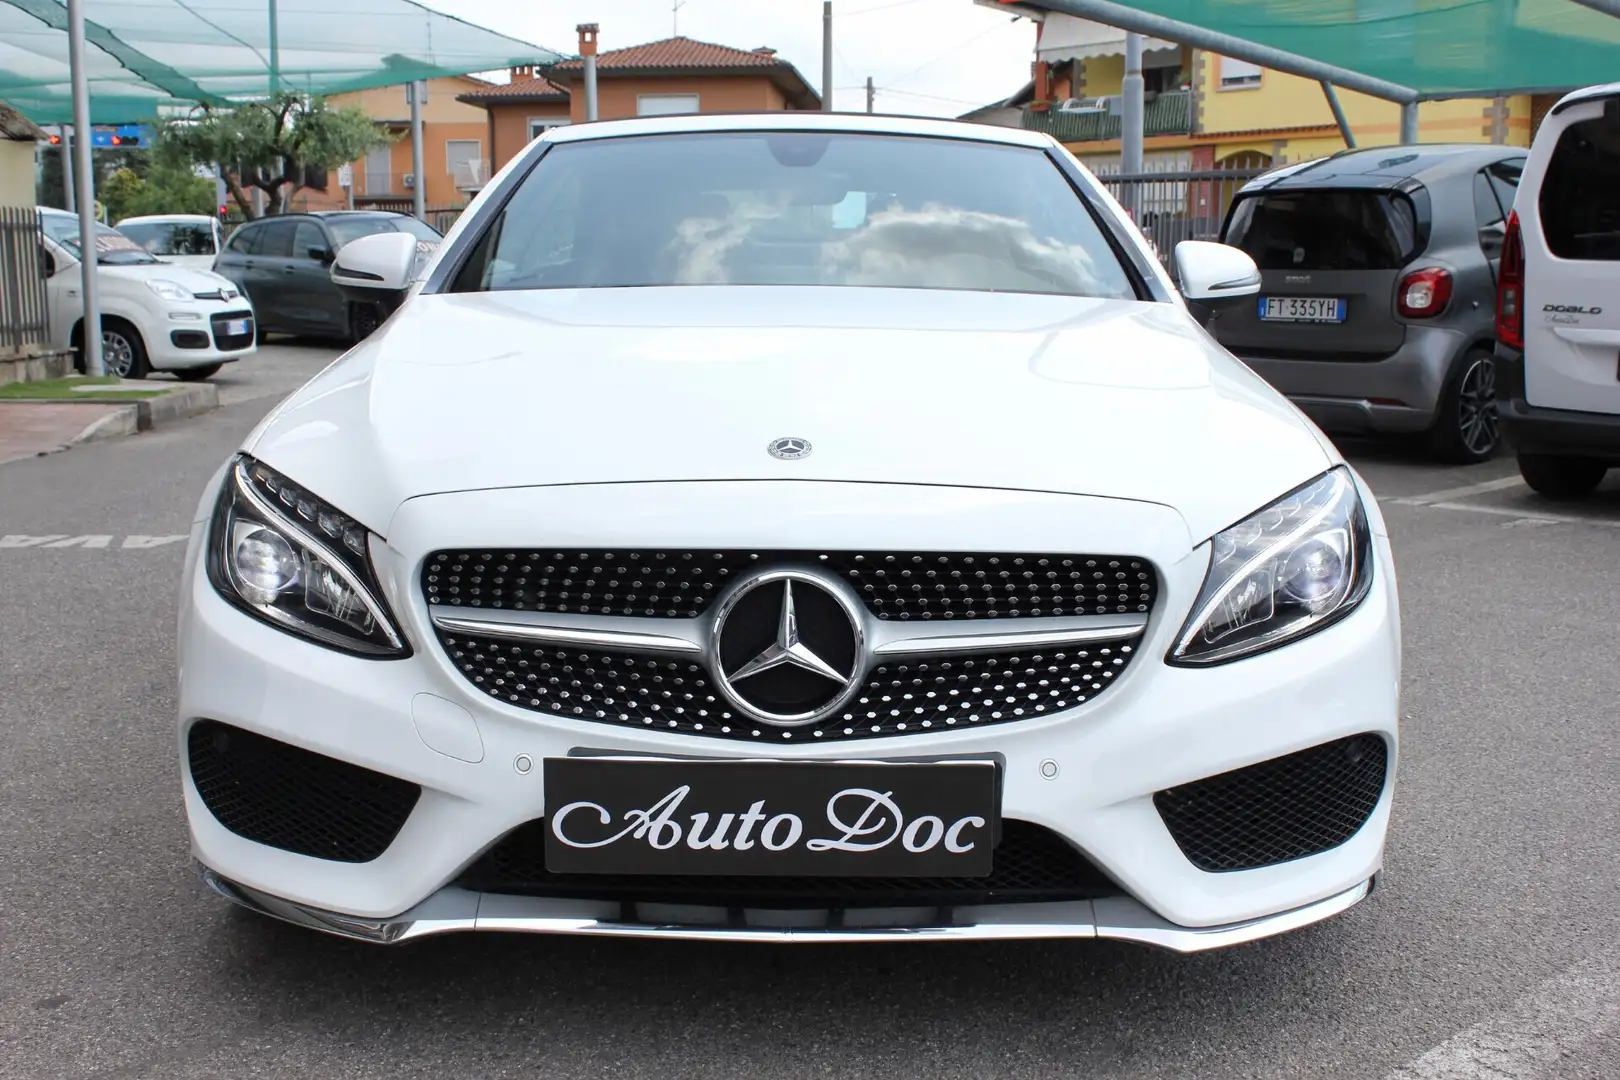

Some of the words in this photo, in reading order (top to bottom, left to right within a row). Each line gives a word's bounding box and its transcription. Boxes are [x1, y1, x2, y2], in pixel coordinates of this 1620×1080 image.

[1267, 299, 1284, 315] FT
[1290, 299, 1336, 317] 335YH
[1543, 304, 1603, 315] DOBLO
[552, 784, 803, 851] Auto
[806, 788, 986, 852] Doc
